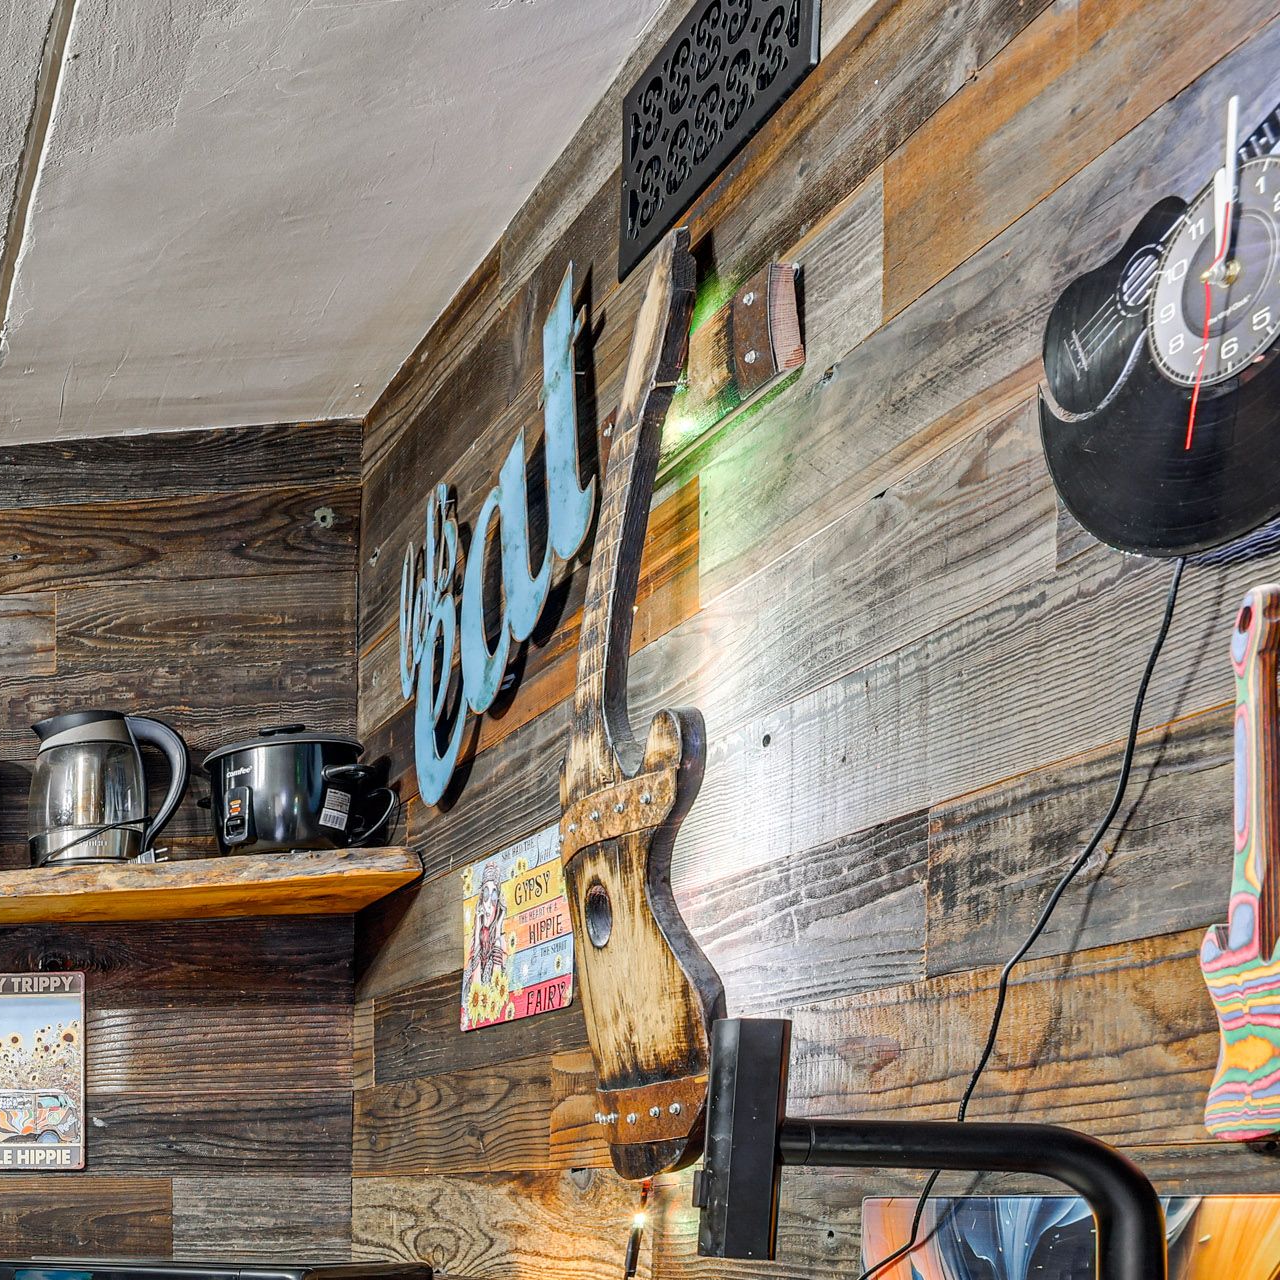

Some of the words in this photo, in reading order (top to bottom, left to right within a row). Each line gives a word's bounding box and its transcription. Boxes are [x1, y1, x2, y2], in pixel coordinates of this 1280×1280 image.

[514, 870, 550, 906] GYPSY
[519, 914, 528, 924] THE
[529, 907, 545, 922] HEART
[529, 914, 563, 944] HIPPIE
[540, 946, 550, 957] THE
[11, 976, 74, 992] TRIPPY
[526, 981, 566, 1015] FAIRY
[17, 1149, 71, 1165] HIPPIE
